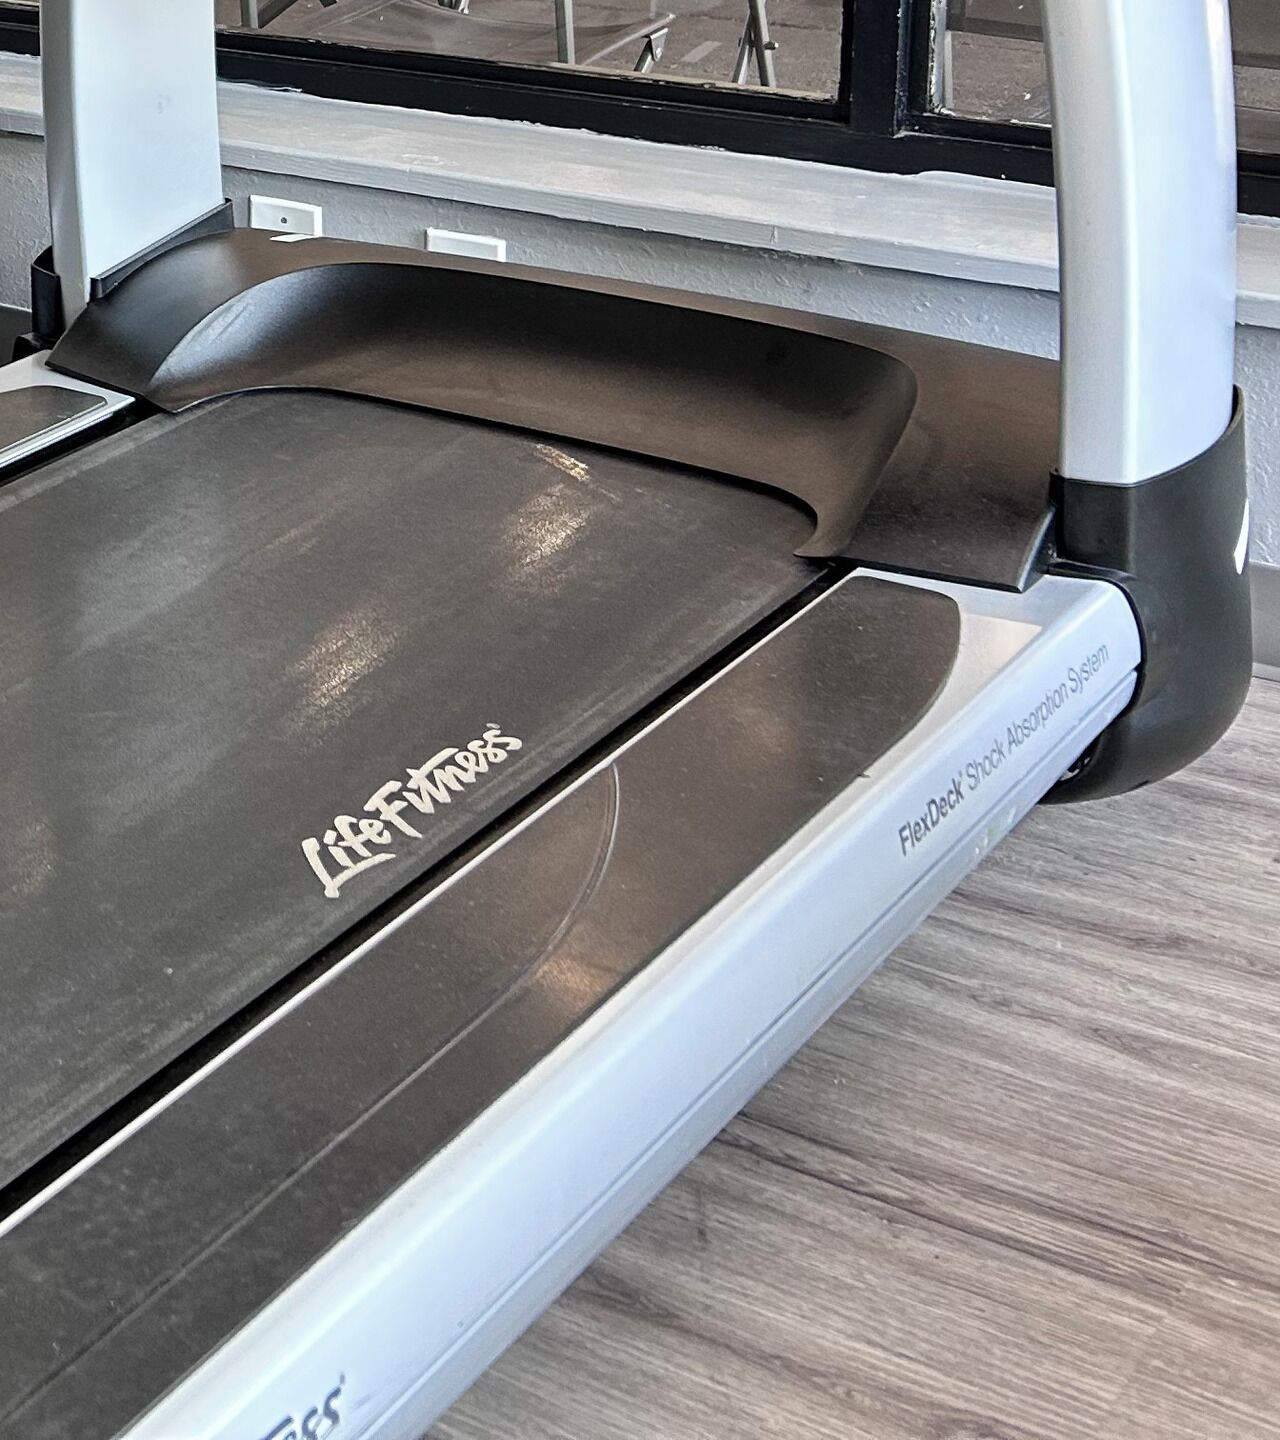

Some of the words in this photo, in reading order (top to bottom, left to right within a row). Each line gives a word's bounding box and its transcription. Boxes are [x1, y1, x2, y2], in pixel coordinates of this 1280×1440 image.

[965, 740, 1008, 791] Shock
[1007, 682, 1069, 756] Absorption
[1067, 643, 1110, 695] System
